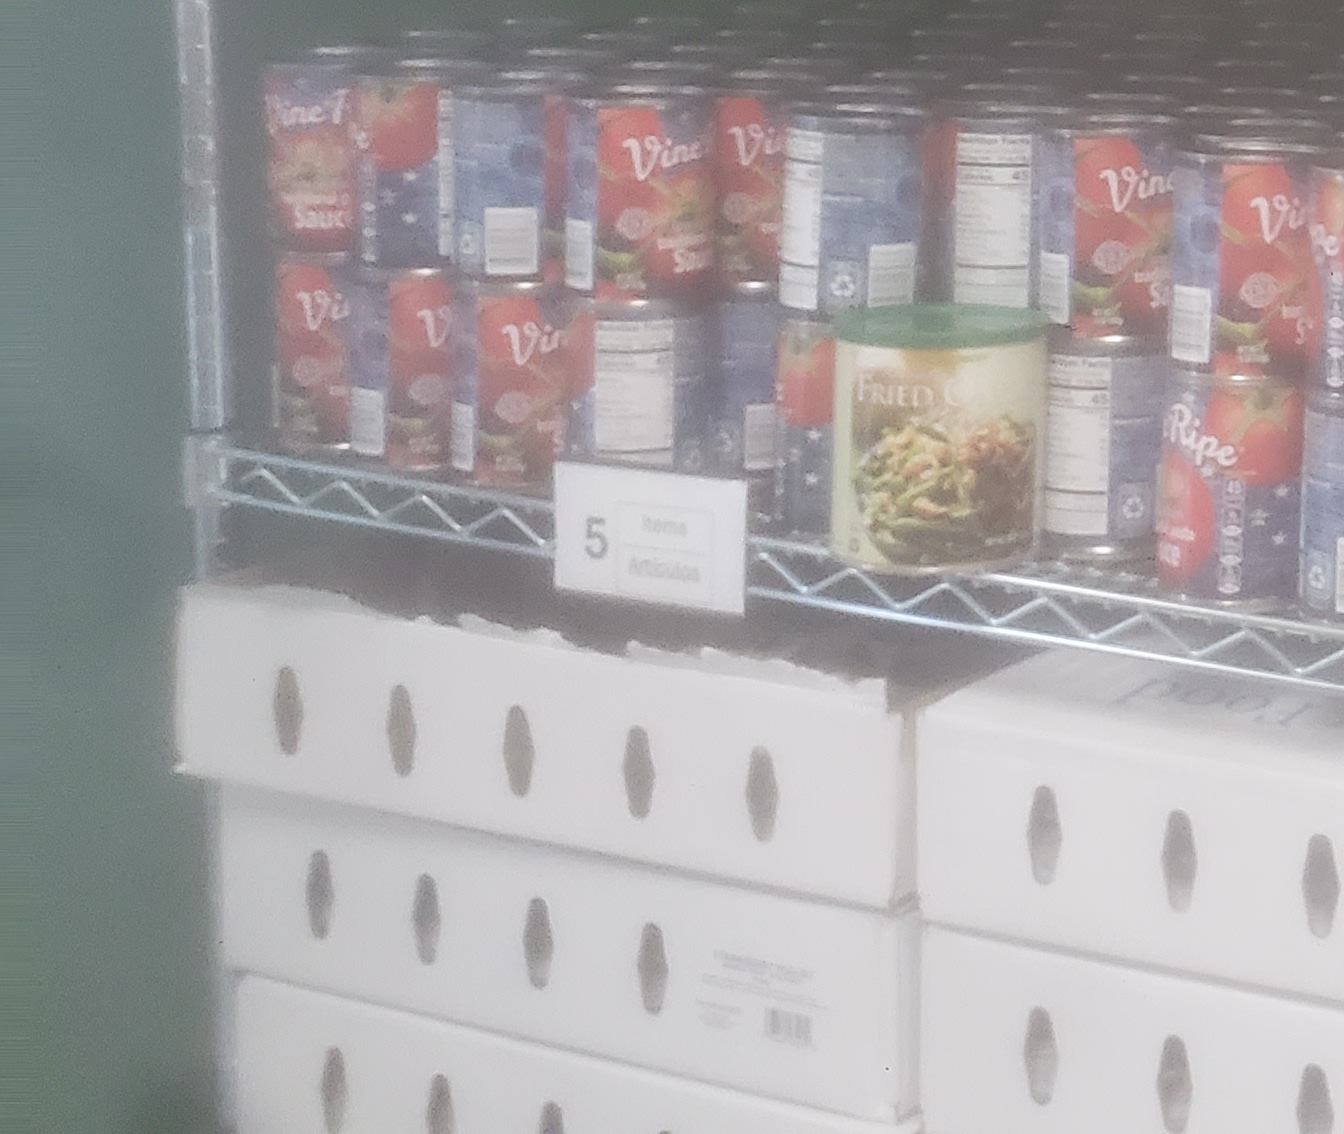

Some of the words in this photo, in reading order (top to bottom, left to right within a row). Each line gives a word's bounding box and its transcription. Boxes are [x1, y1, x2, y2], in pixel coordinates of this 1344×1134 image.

[857, 371, 934, 408] FRIED
[1163, 402, 1239, 468] Ripe
[584, 515, 608, 560] 5
